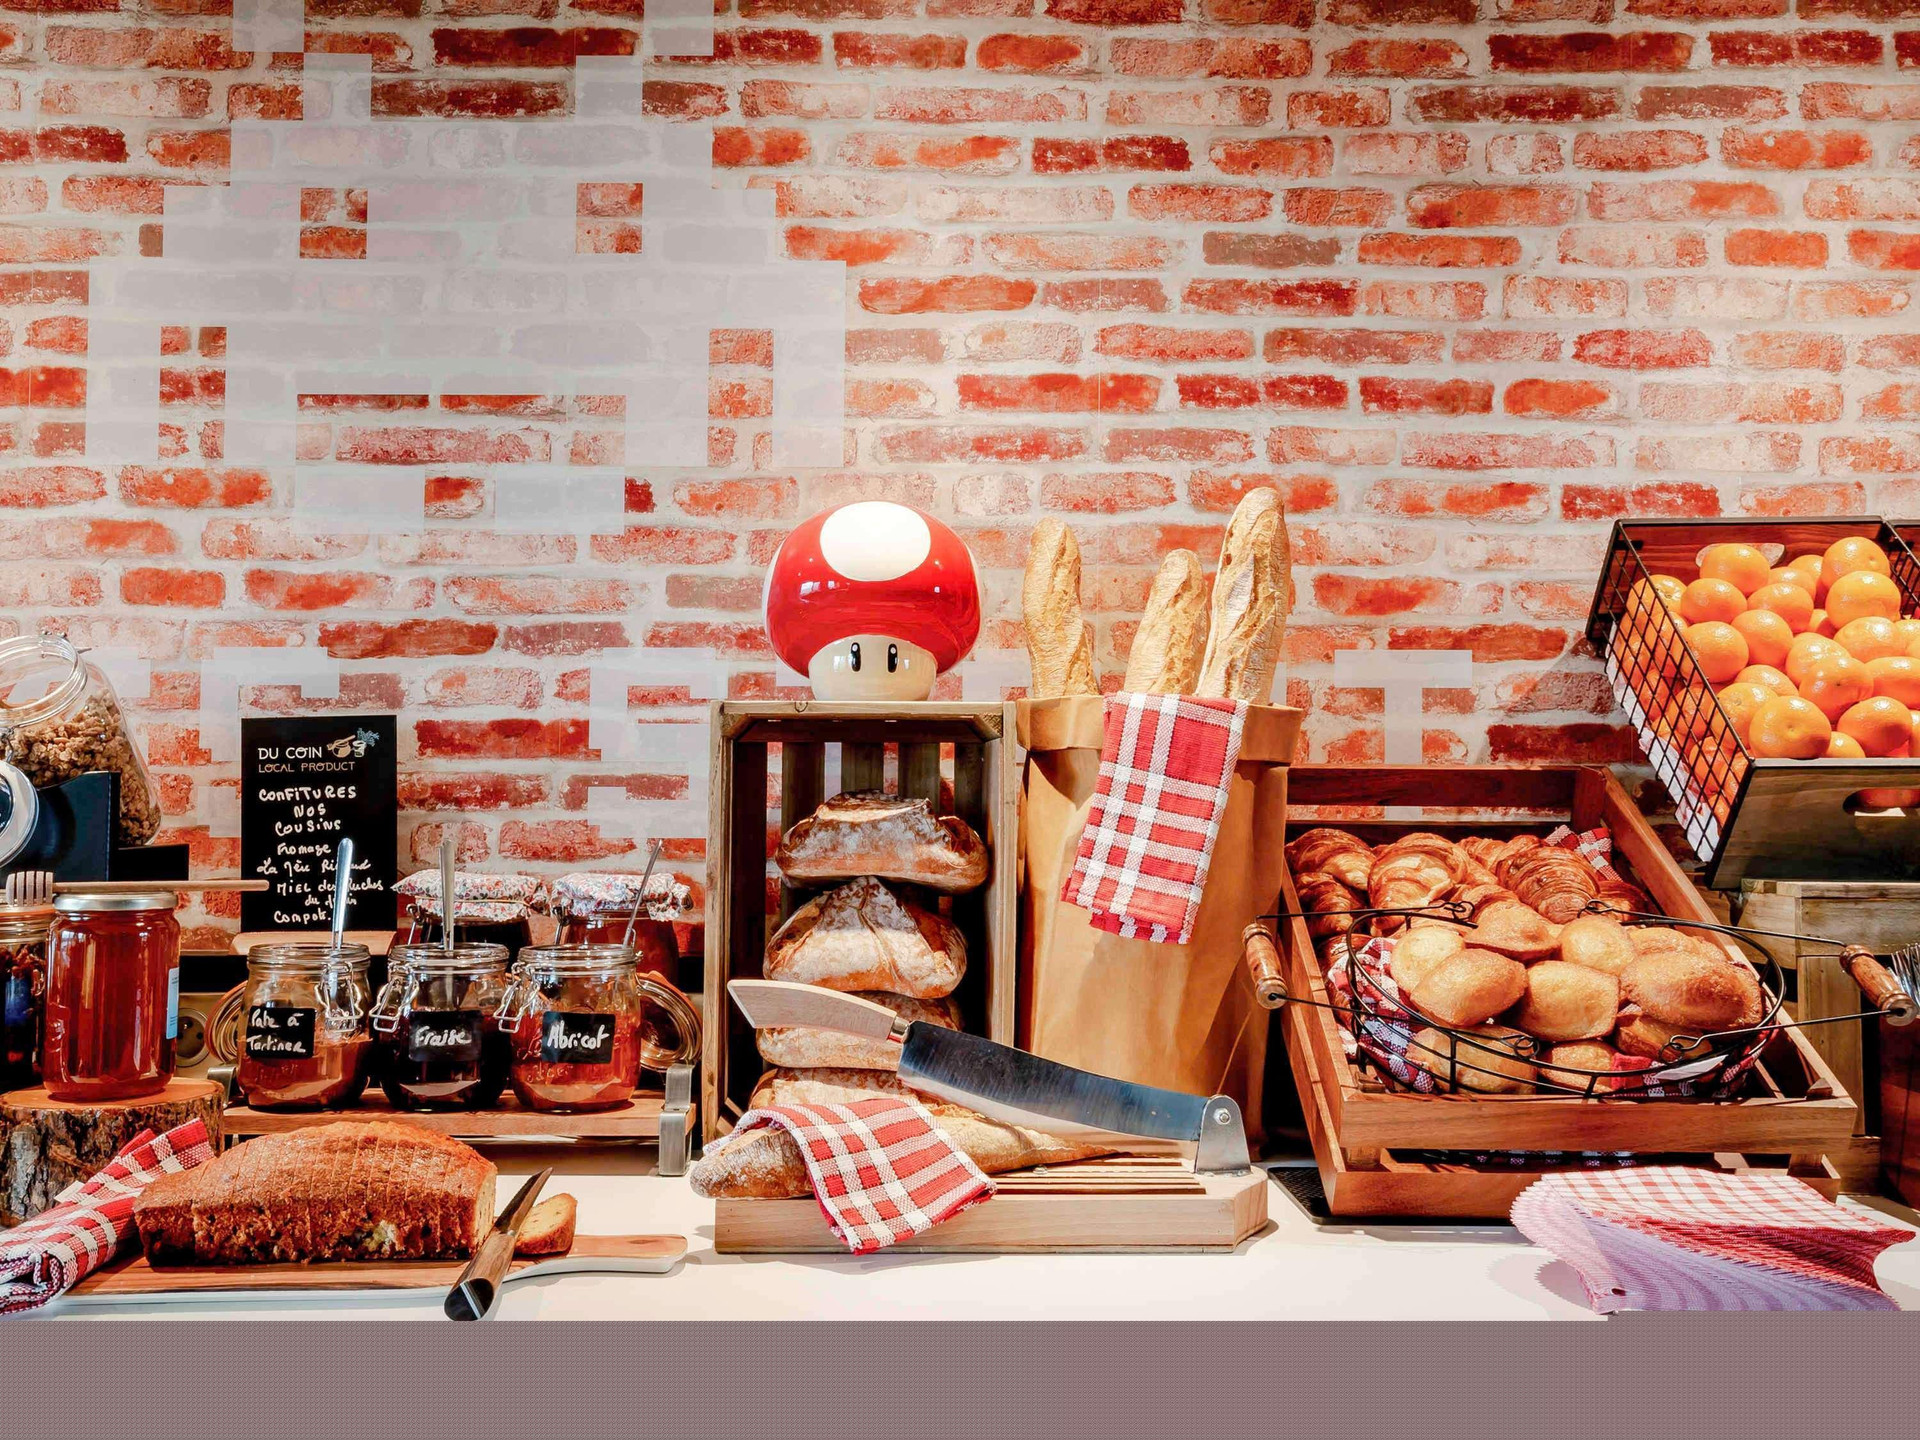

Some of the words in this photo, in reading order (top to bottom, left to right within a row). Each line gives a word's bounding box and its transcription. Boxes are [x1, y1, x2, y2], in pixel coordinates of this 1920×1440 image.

[258, 747, 279, 760] DU
[285, 746, 322, 759] COIN
[258, 763, 295, 773] LOCAL
[301, 761, 355, 771] PRODUCT
[277, 843, 331, 856] Fromage
[415, 1025, 472, 1047] Fraise
[547, 1020, 610, 1049] Abricot
